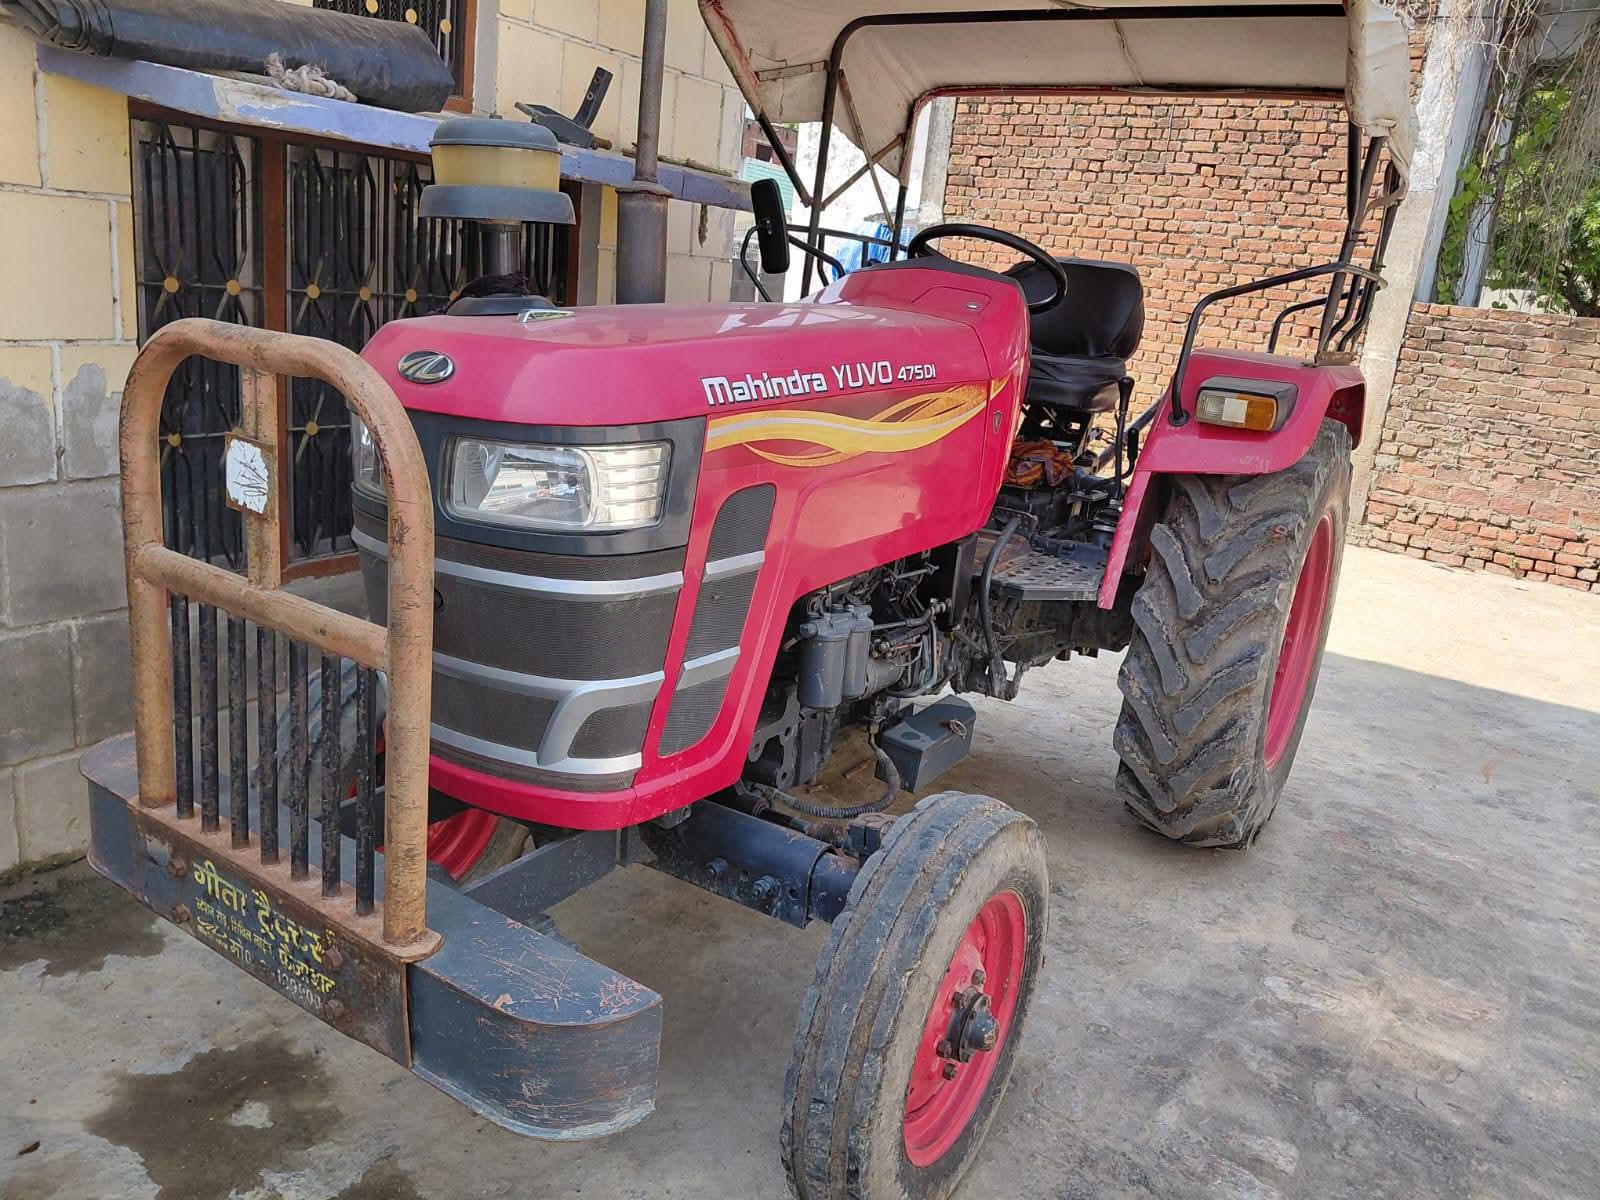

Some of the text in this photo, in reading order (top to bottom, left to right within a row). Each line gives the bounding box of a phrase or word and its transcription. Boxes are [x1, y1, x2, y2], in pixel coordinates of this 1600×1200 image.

[701, 360, 936, 406] Mahindra YUVO 475DI
[192, 859, 248, 917] गीता
